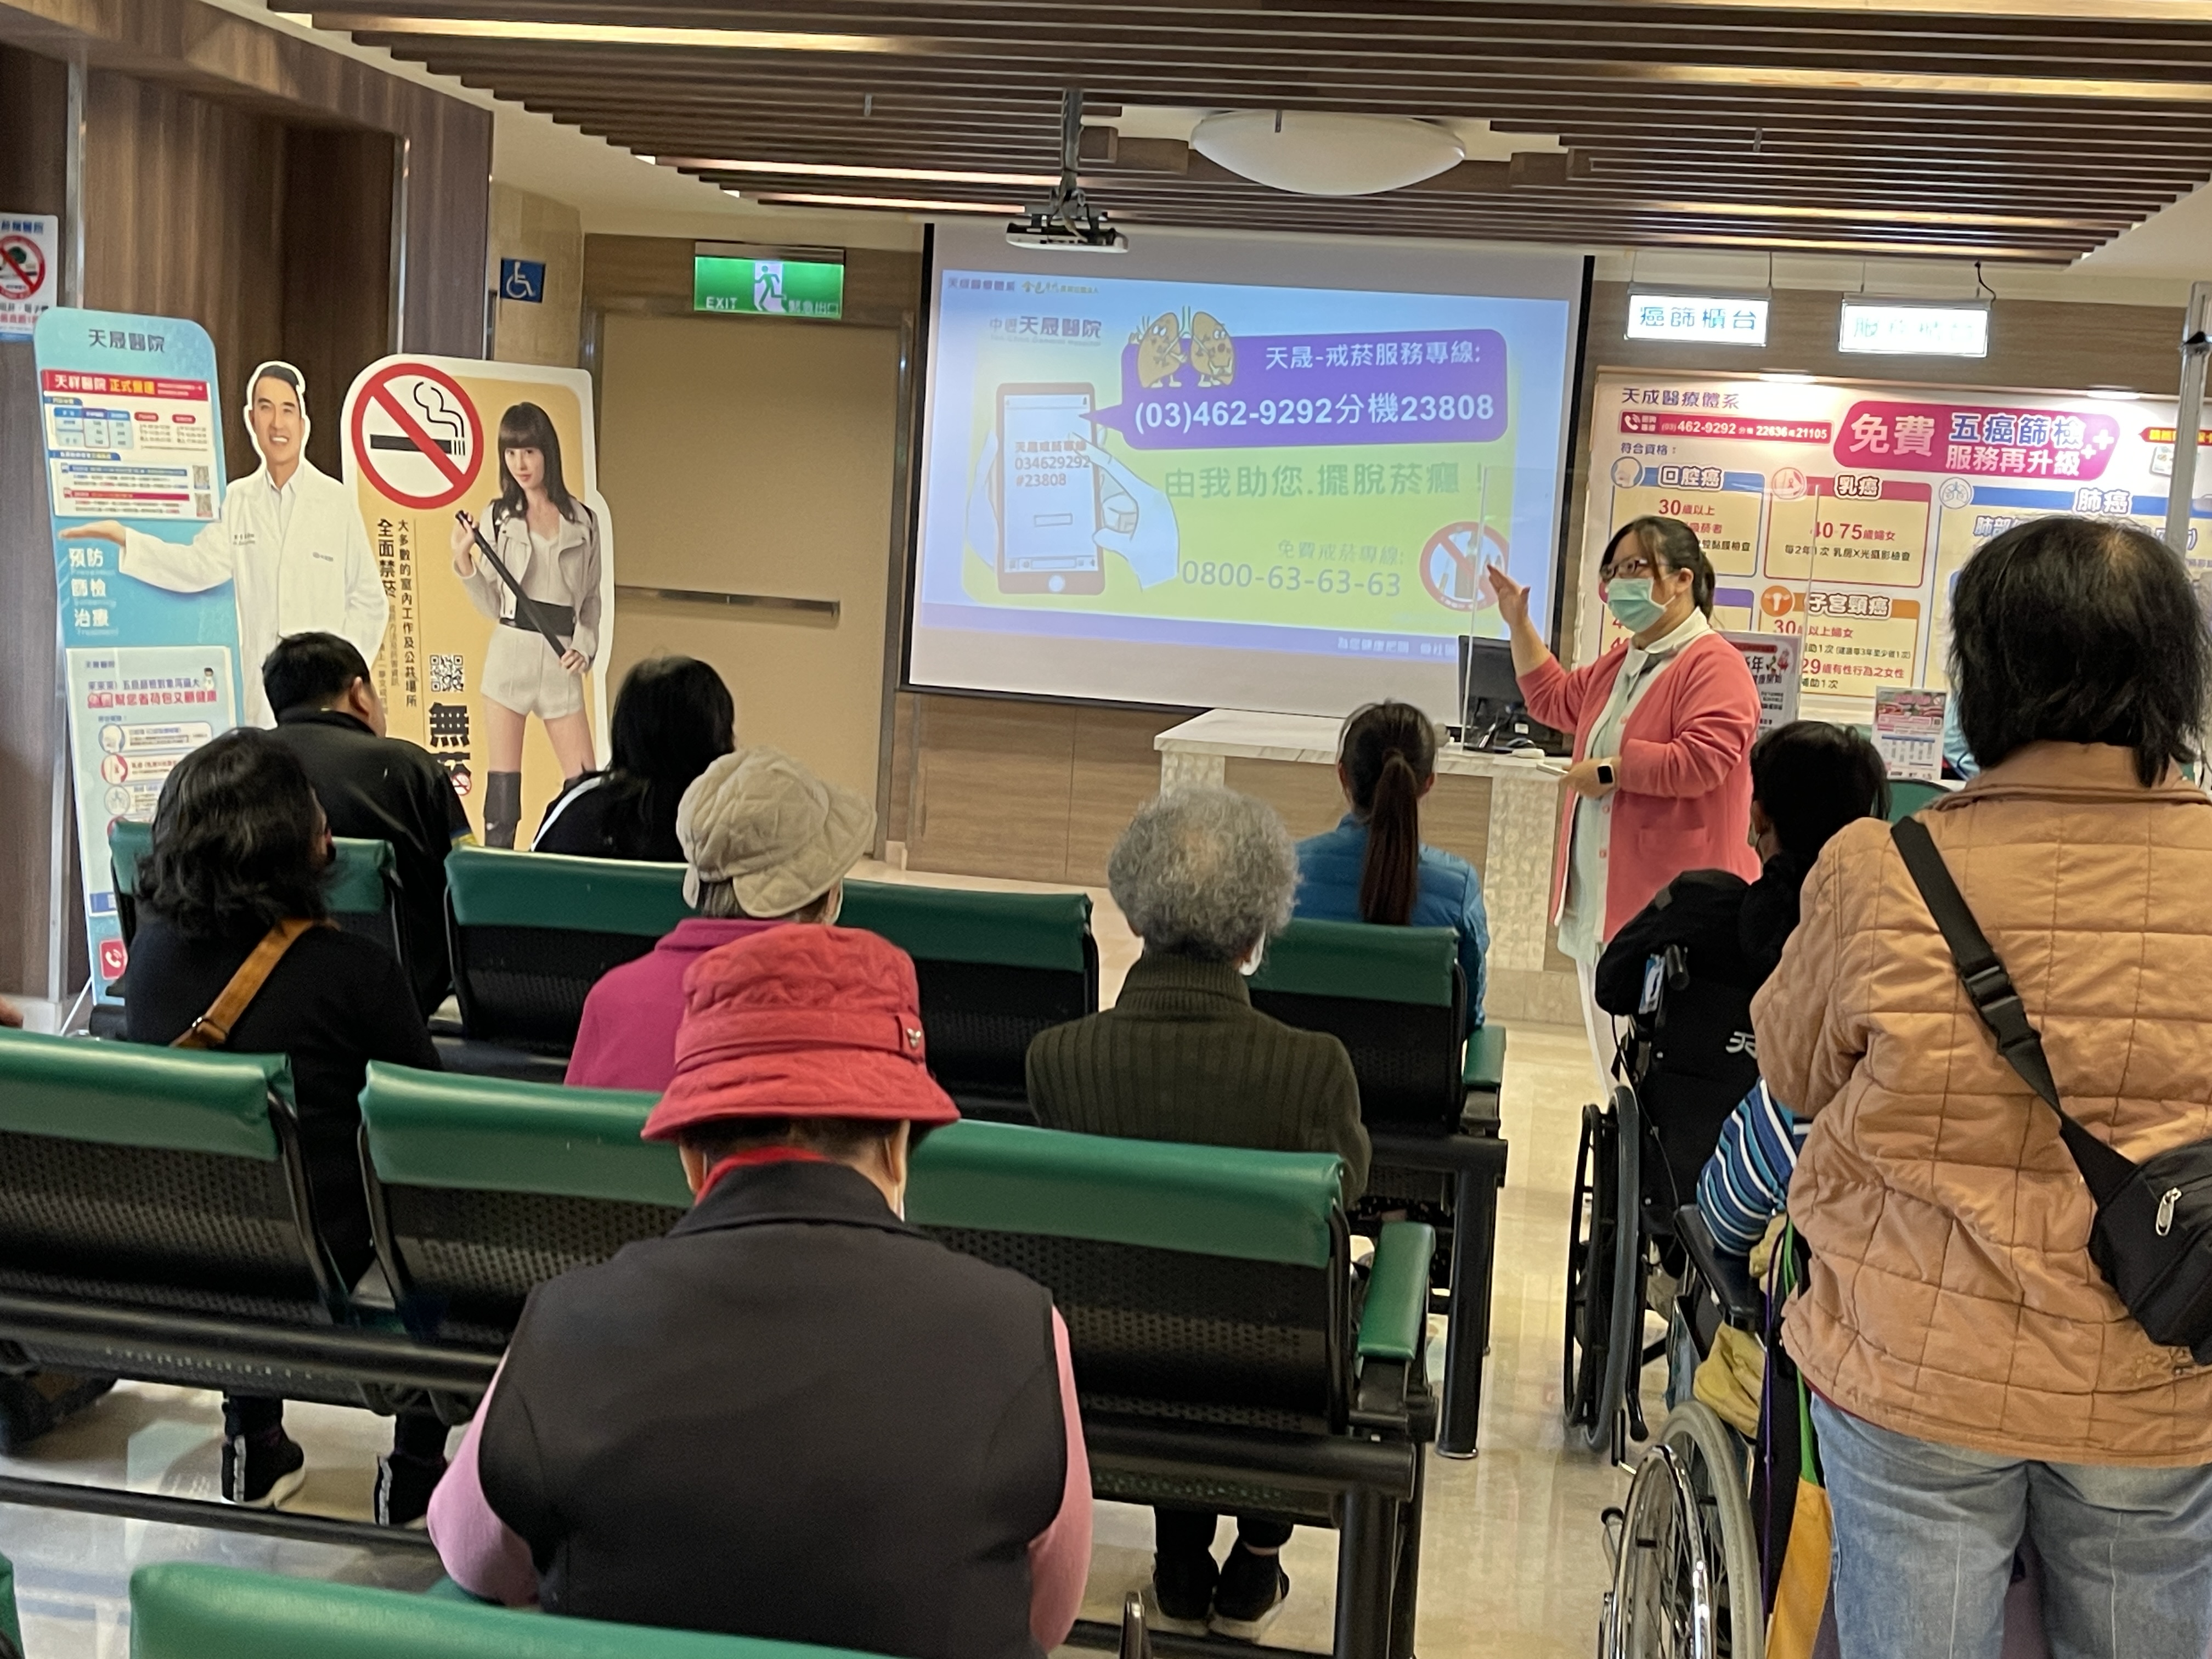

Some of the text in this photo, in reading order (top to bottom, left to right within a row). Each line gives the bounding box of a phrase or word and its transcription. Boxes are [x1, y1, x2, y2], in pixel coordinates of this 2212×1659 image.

[706, 296, 737, 309] EXIT
[1639, 307, 1756, 330] 癌篩櫃台
[1266, 341, 1481, 371] 天晟-戒菸服務專線:
[1622, 388, 1740, 409] 天成醫療體系
[1135, 393, 1494, 434] (03)462-9292分機23808
[1849, 413, 1936, 456] 免費
[1949, 413, 2085, 448] 五癌篩檢
[1945, 445, 2081, 476] 服務再升級
[1660, 465, 1722, 487] 口腔癌
[1837, 475, 1880, 498] 乳癌
[1658, 499, 1716, 516] 30歲以上
[2075, 487, 2131, 514] 肺癌
[1700, 539, 1751, 551] 腔黏膜檢查
[69, 548, 103, 567] 預防
[378, 518, 396, 599] 全面禁菸
[1182, 561, 1401, 597] 0800-63-63-63
[1808, 592, 1890, 616] 子宮頸癌
[75, 608, 109, 627] 治療
